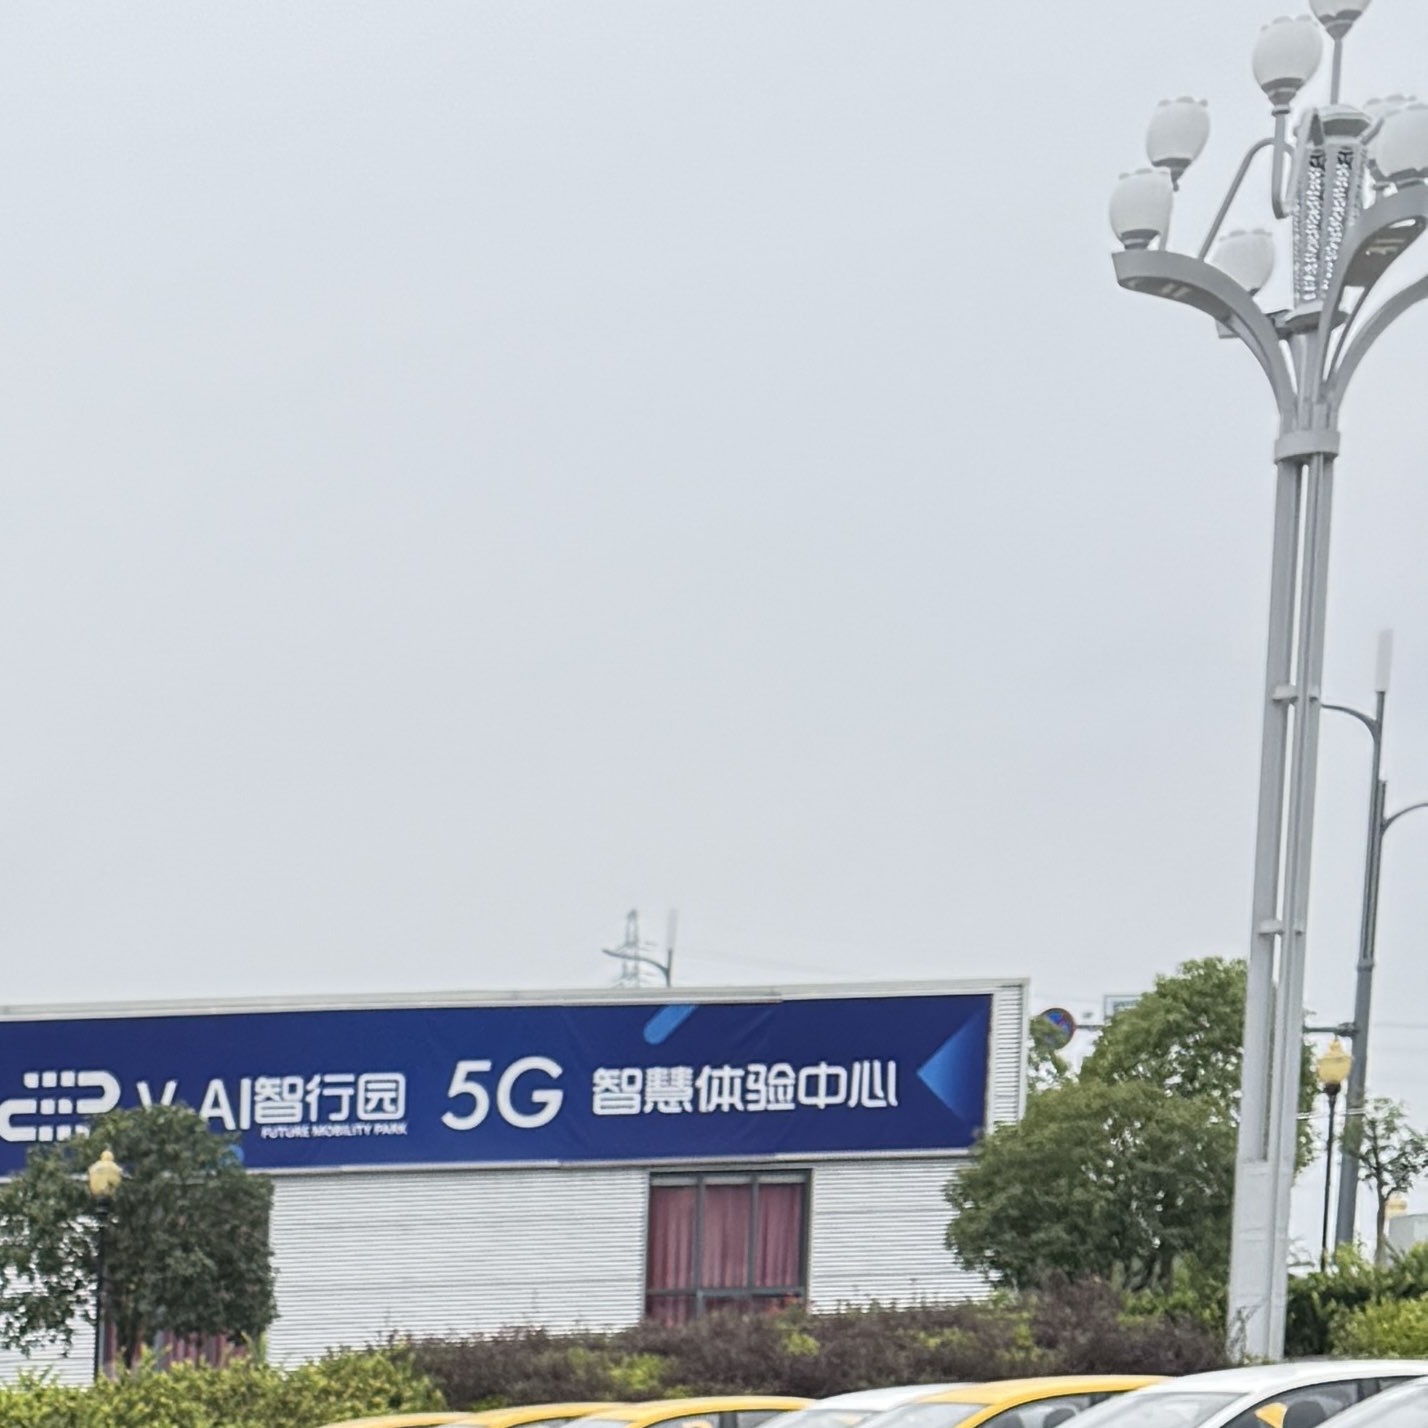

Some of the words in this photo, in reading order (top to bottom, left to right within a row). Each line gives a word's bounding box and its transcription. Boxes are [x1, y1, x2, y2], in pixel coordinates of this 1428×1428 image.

[441, 1056, 563, 1130] 5G
[592, 1060, 898, 1115] 智慧体验中心
[261, 1125, 310, 1139] FUTURE
[312, 1123, 372, 1137] MOBILITY
[373, 1122, 408, 1135] PARK
